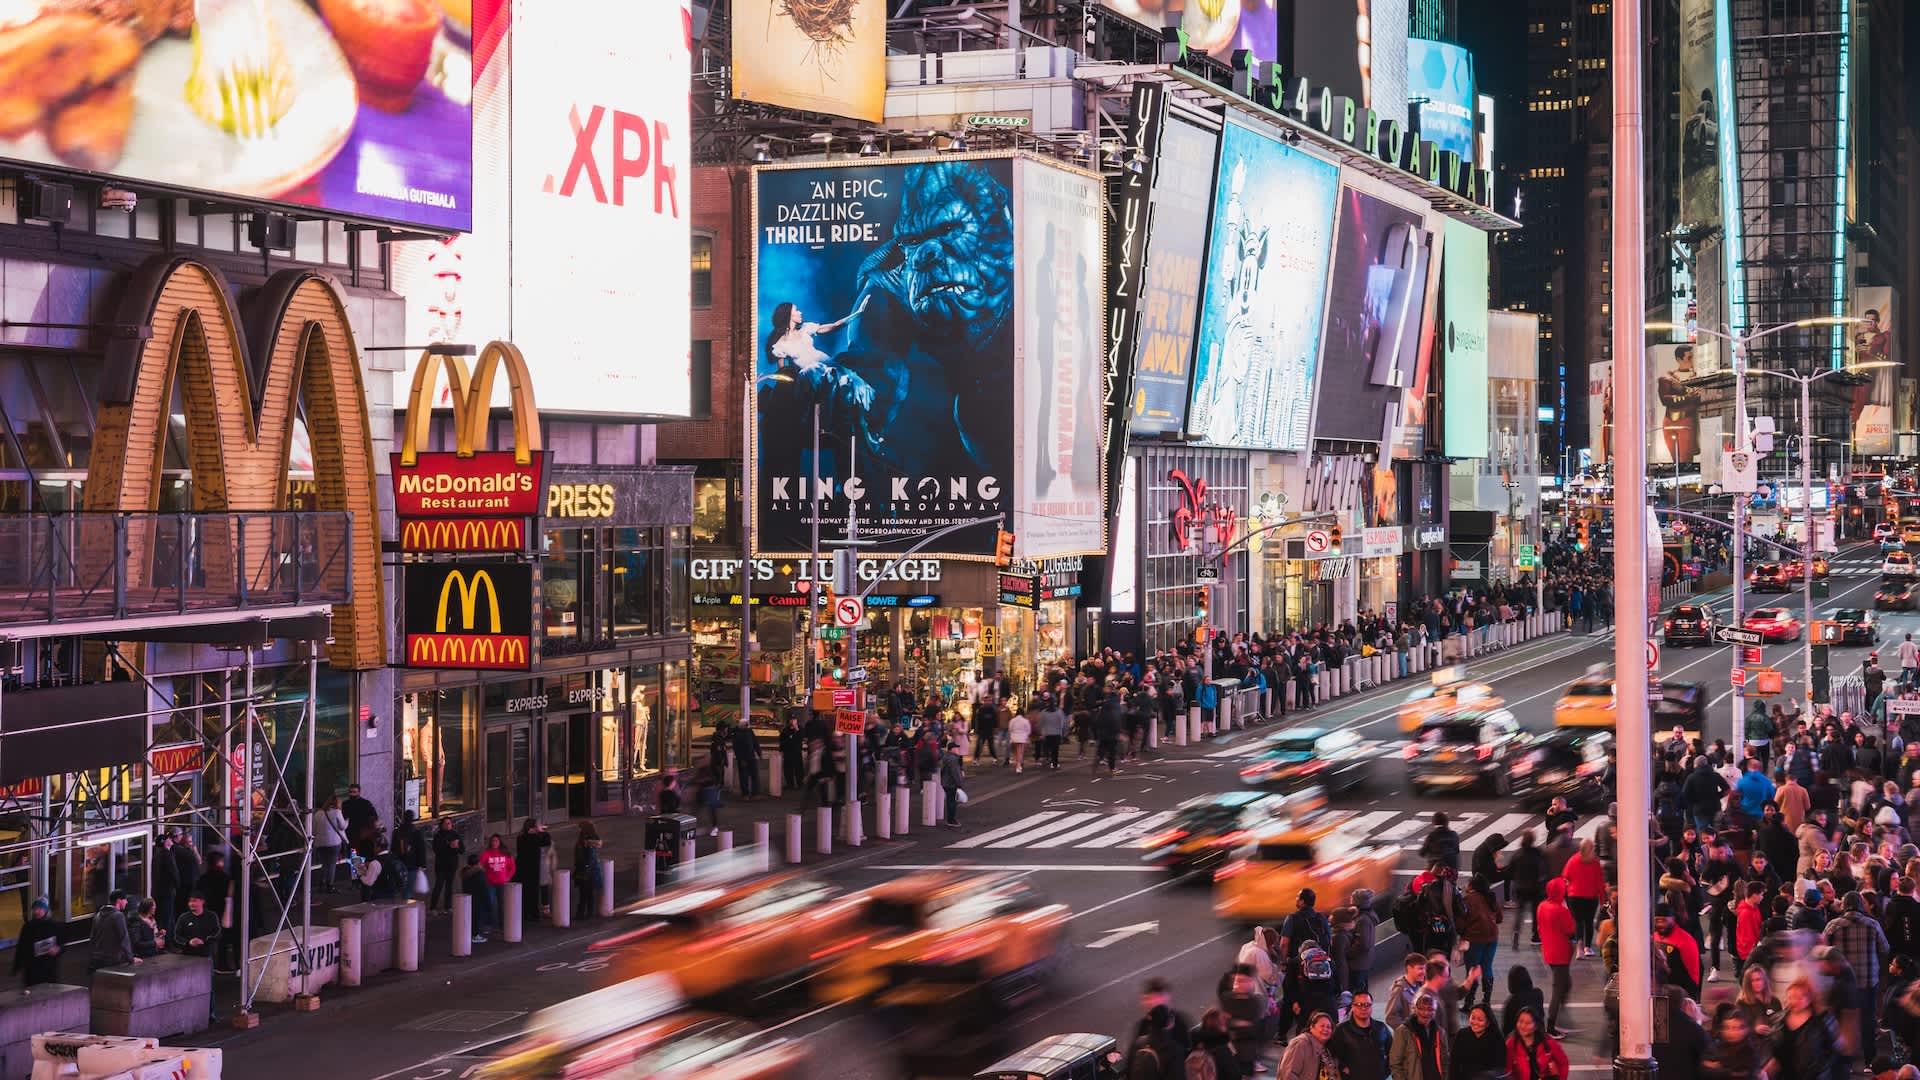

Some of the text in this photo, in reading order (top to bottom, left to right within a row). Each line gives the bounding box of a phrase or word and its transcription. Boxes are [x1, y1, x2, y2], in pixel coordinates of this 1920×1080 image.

[971, 116, 1024, 125] LAMAR
[1243, 50, 1491, 212] 1540 BROADWAY
[843, 179, 888, 198] EPIC,
[777, 203, 865, 223] DAZZLING
[765, 226, 826, 245] THRILL
[400, 473, 533, 493] McDonald's
[772, 476, 1000, 500] KING KONG
[421, 496, 510, 509] Restaurant
[547, 484, 615, 517] PRESS
[891, 502, 1000, 511] BROADWAY
[690, 559, 940, 581] GIFTS LUGAGE
[1043, 556, 1082, 573] LUGGAGE
[730, 595, 759, 604] Nion
[769, 596, 808, 605] Canon
[867, 597, 896, 605] BOWER
[1054, 588, 1068, 597] SONY
[1721, 630, 1757, 641] ONE WAY
[508, 695, 548, 713] EXPRESS
[569, 688, 606, 703] EXPRESS
[840, 713, 862, 721] RAISE
[839, 721, 860, 731] PLOW
